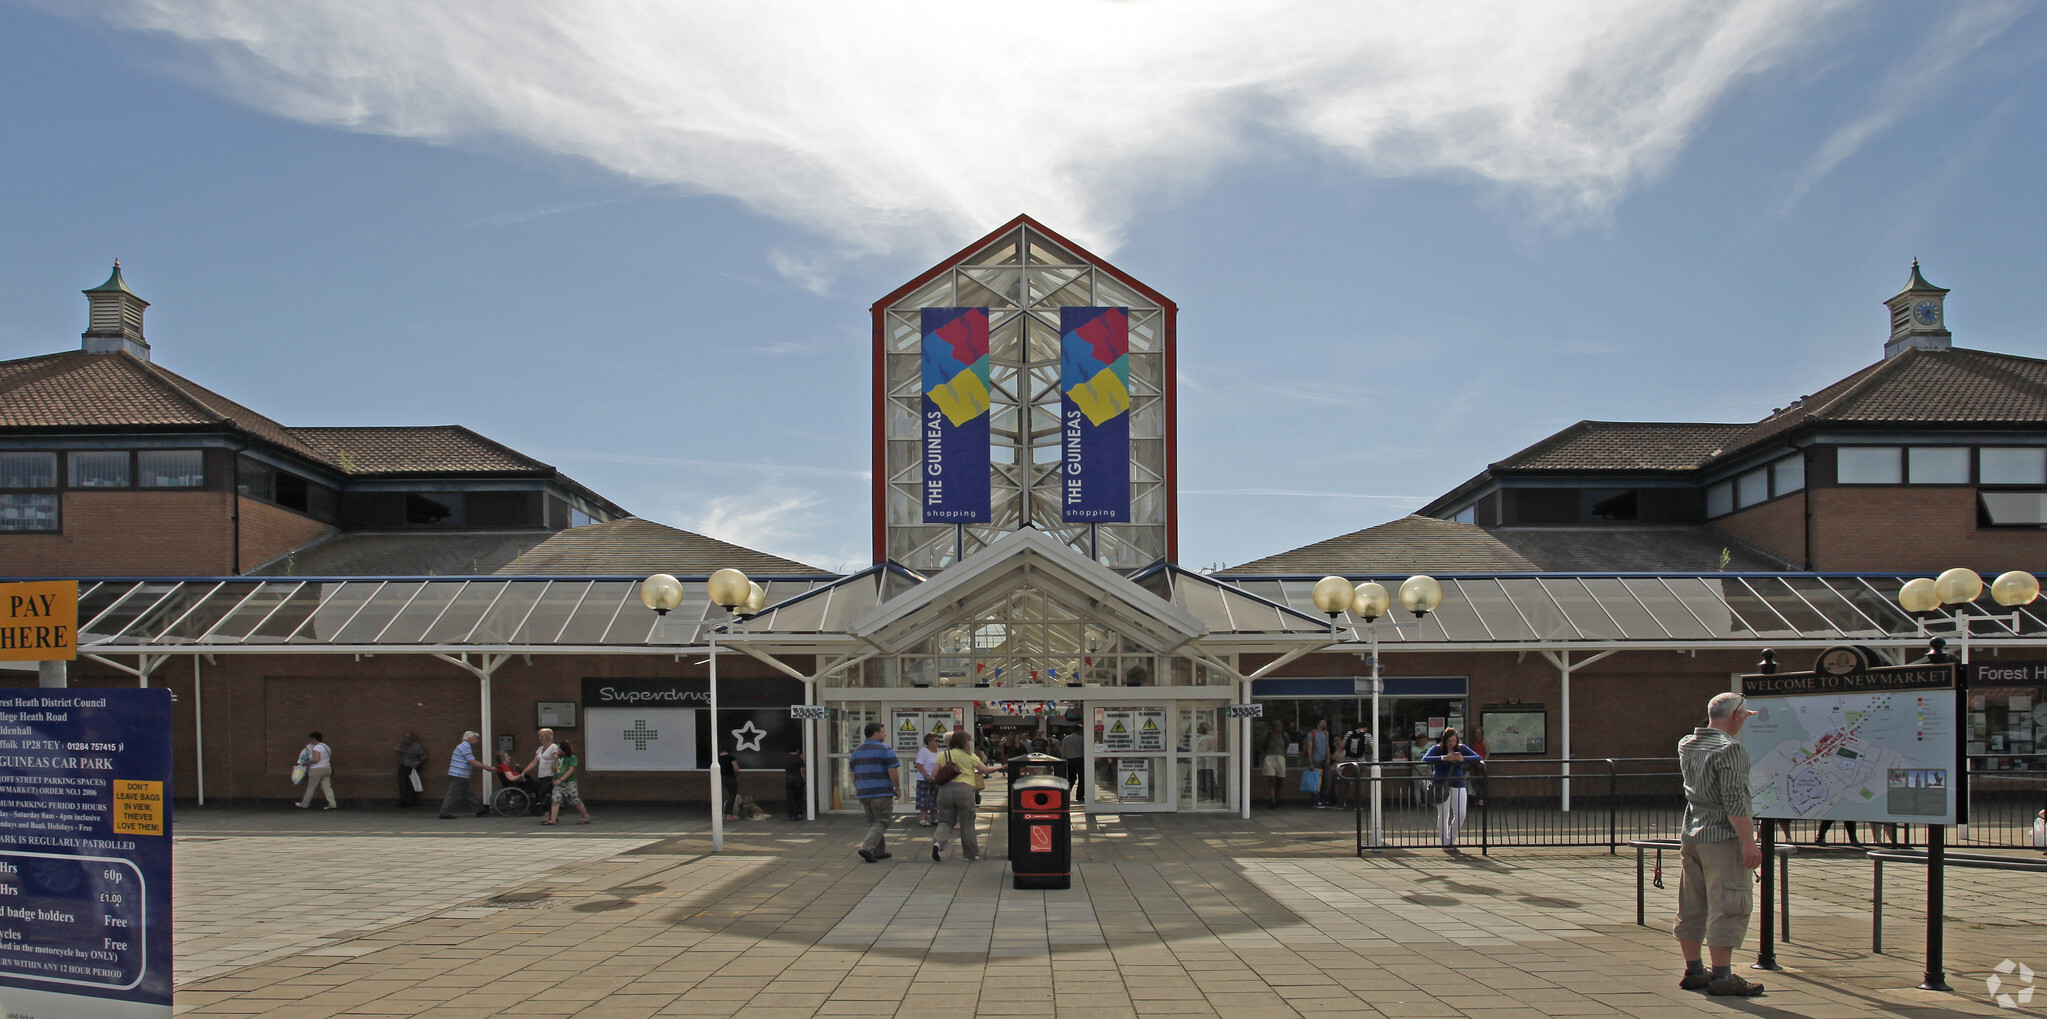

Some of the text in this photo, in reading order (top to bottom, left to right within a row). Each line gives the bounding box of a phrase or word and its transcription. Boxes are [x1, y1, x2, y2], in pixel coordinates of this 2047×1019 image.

[928, 411, 942, 506] THE GUINEAS
[1068, 410, 1082, 504] THE GUINEAS
[926, 510, 976, 518] shopping
[1066, 509, 1116, 518] shopping
[10, 594, 56, 618] PAY
[0, 625, 68, 649] HERE
[1979, 666, 2028, 680] Forest
[1746, 677, 1815, 690] WELCOME
[1820, 676, 1839, 688] TO
[1844, 670, 1948, 687] NEWMARKET
[600, 687, 712, 704] Superdrug
[15, 698, 39, 707] Heath
[42, 698, 71, 707] District
[74, 698, 106, 707] Council
[20, 712, 43, 721] Heath
[46, 712, 67, 721] Road
[22, 740, 40, 749] IP28
[43, 741, 60, 749] 7EY
[0, 756, 113, 770] GUINEAS CAR PARK
[77, 778, 106, 787] SPACES)
[14, 811, 40, 820] Saturday
[60, 813, 73, 821] 4pm
[123, 812, 152, 820] THIEVES
[48, 823, 73, 832] Holidays
[0, 835, 17, 843] ARK
[28, 836, 80, 847] REGULARLY
[83, 839, 135, 850] PATROLLED
[0, 862, 17, 873] Hrs
[104, 869, 122, 883] 60p
[0, 884, 18, 895] Hrs
[100, 893, 122, 903] £1.00
[7, 906, 35, 921] badge
[38, 909, 75, 922] holders
[104, 915, 127, 927] Free
[104, 938, 127, 950] Free
[22, 944, 33, 952] the
[35, 945, 74, 957] motorcycle
[76, 949, 88, 960] bay
[90, 950, 118, 963] ONLY)
[14, 960, 41, 969] WITHIN
[43, 963, 59, 971] ANY
[69, 965, 91, 975] HOUR
[93, 968, 122, 978] PERIOD
